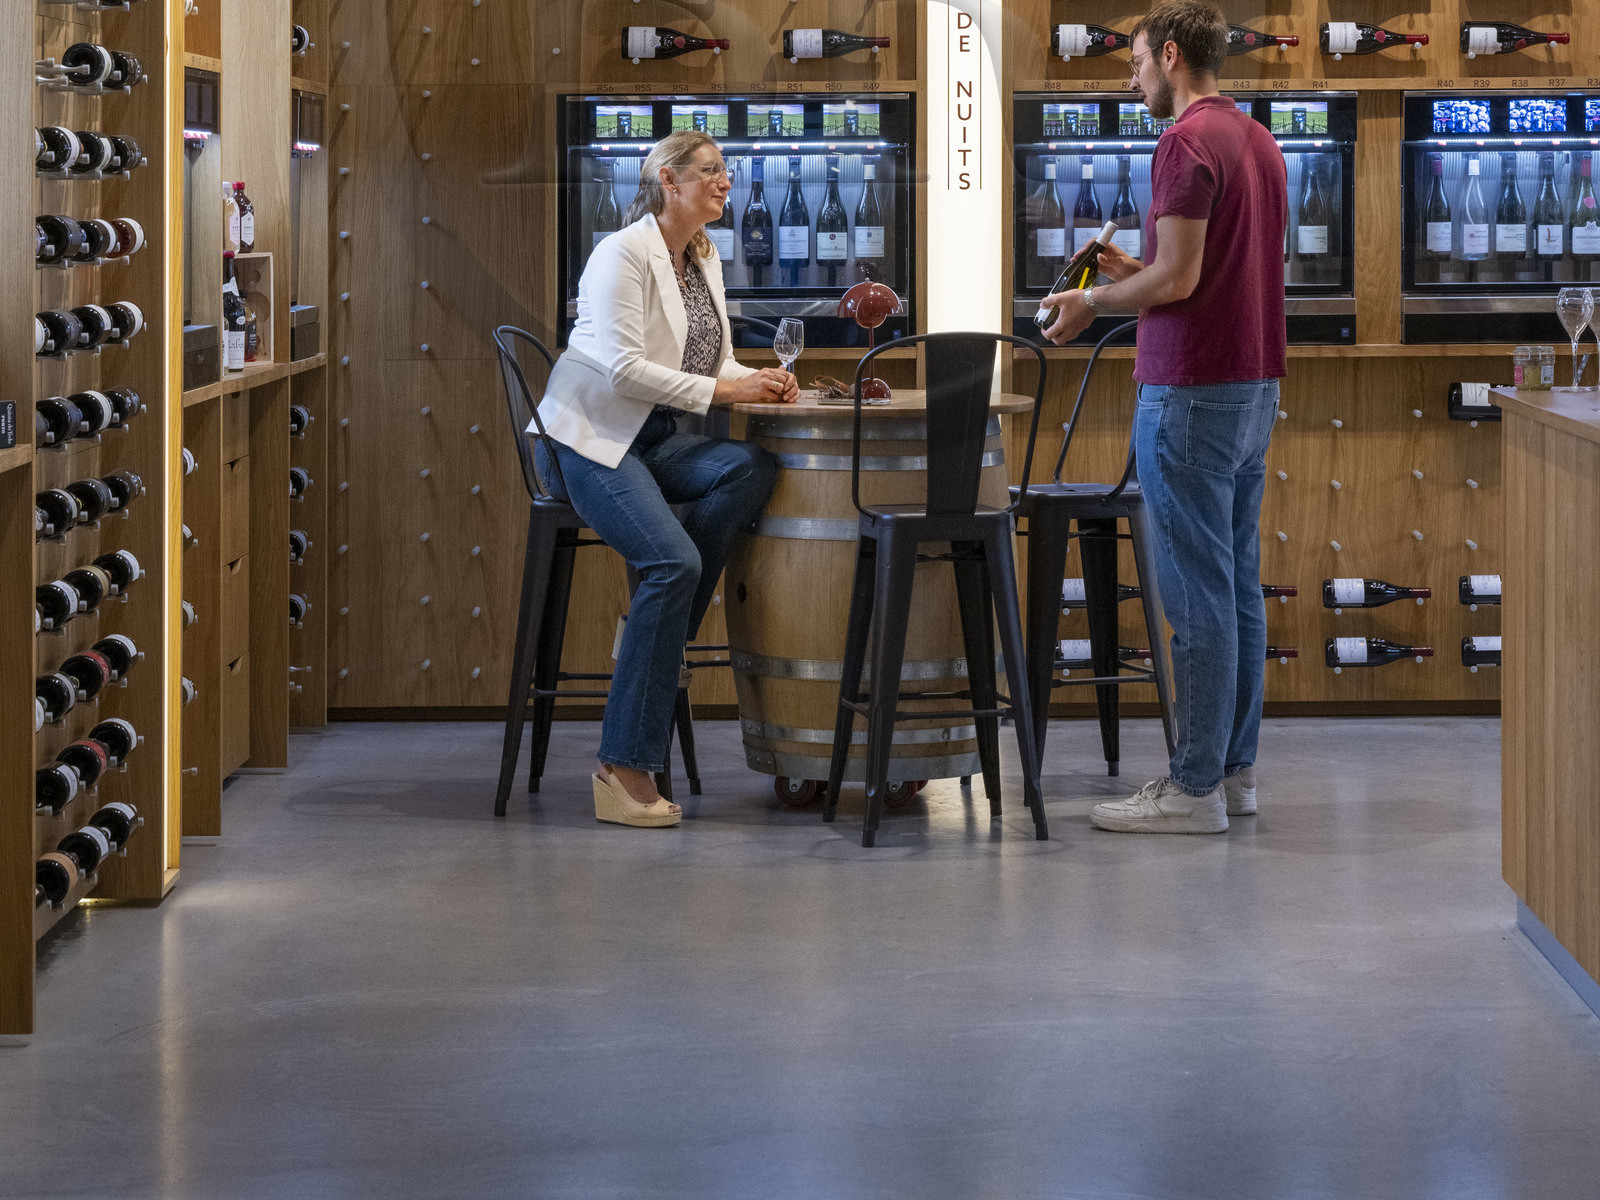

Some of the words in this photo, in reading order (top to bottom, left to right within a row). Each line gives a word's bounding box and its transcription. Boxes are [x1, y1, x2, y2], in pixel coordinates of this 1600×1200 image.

[958, 13, 971, 51] DE
[635, 84, 652, 92] R55
[672, 84, 688, 92] R54
[711, 84, 728, 92] R53
[750, 84, 767, 92] R52
[1044, 82, 1061, 90] R48
[1084, 82, 1100, 90] R47
[1233, 81, 1250, 89] R43
[1272, 81, 1290, 89] R42
[1312, 80, 1328, 88] R41
[1437, 80, 1454, 88] R40
[1474, 80, 1490, 88] R39
[958, 82, 971, 189] NUITS
